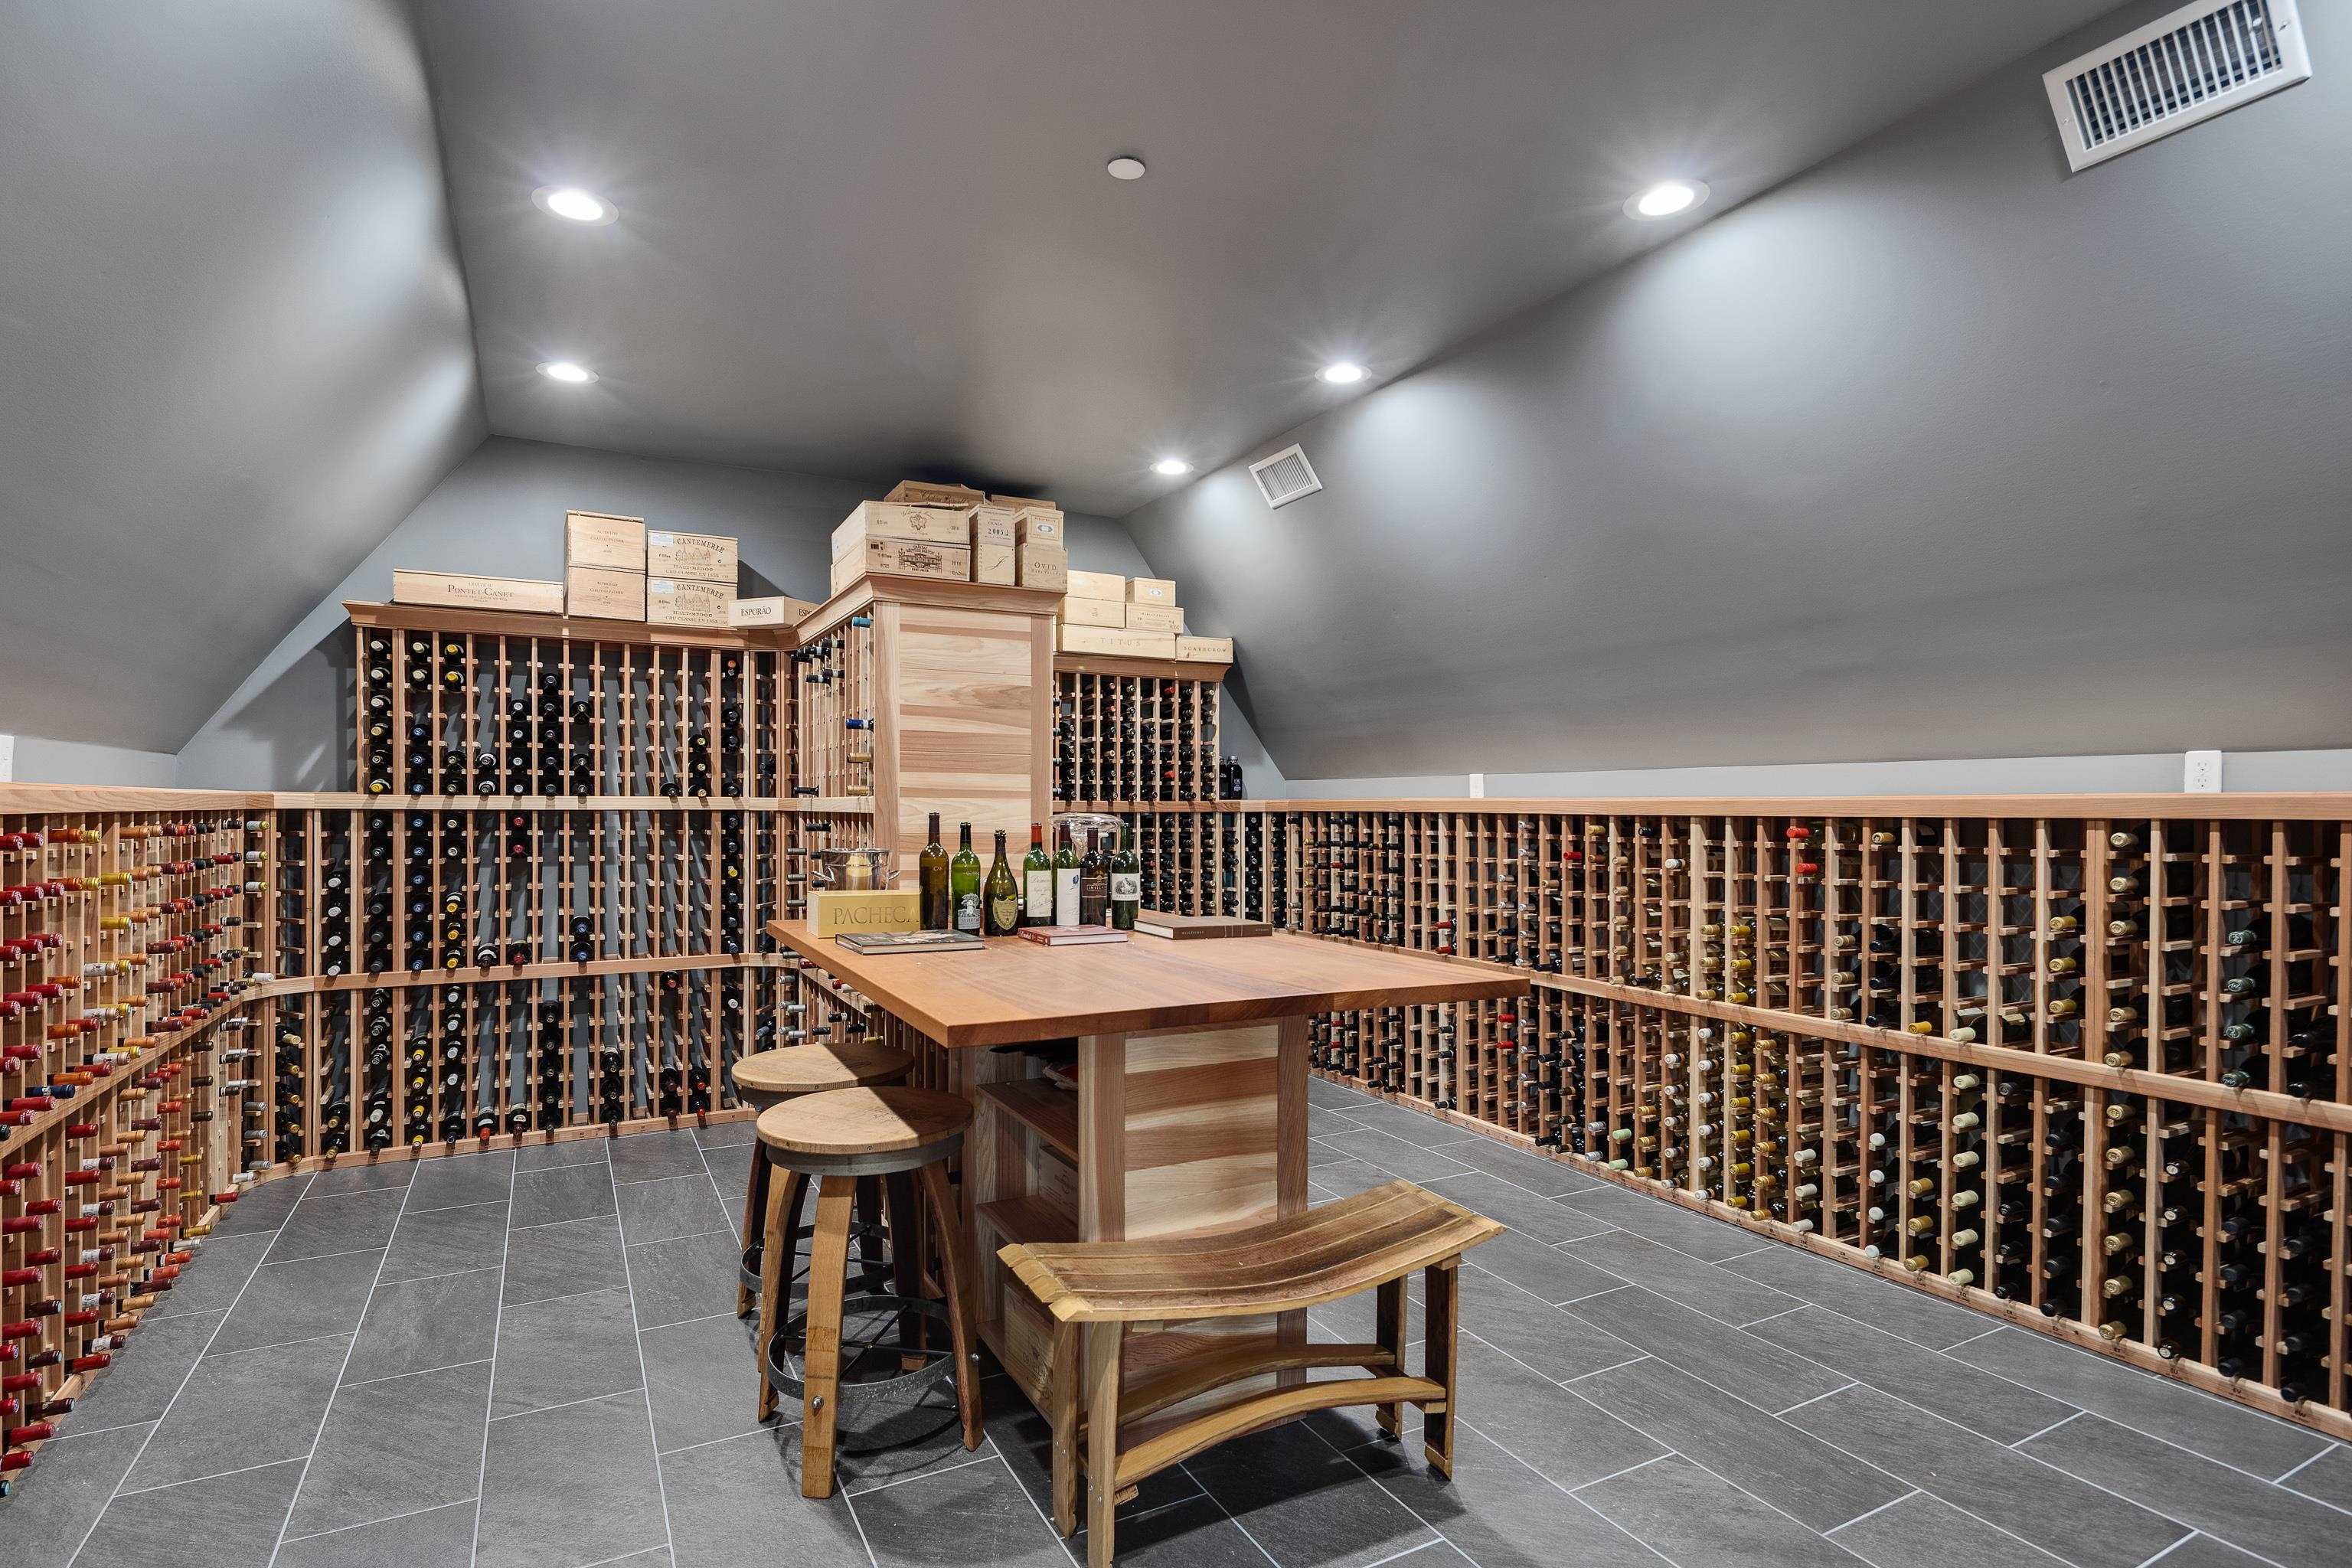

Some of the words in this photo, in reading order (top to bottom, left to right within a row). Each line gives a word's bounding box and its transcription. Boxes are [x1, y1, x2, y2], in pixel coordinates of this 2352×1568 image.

[677, 538, 725, 554] CANTEMERLE
[1034, 561, 1057, 570] OVID
[448, 584, 514, 598] PONTET-CANET
[677, 583, 724, 599] CANTEMERLE
[741, 606, 772, 616] ESPORÃO
[1101, 637, 1141, 646] TITUS
[834, 906, 920, 924] PACHECA
